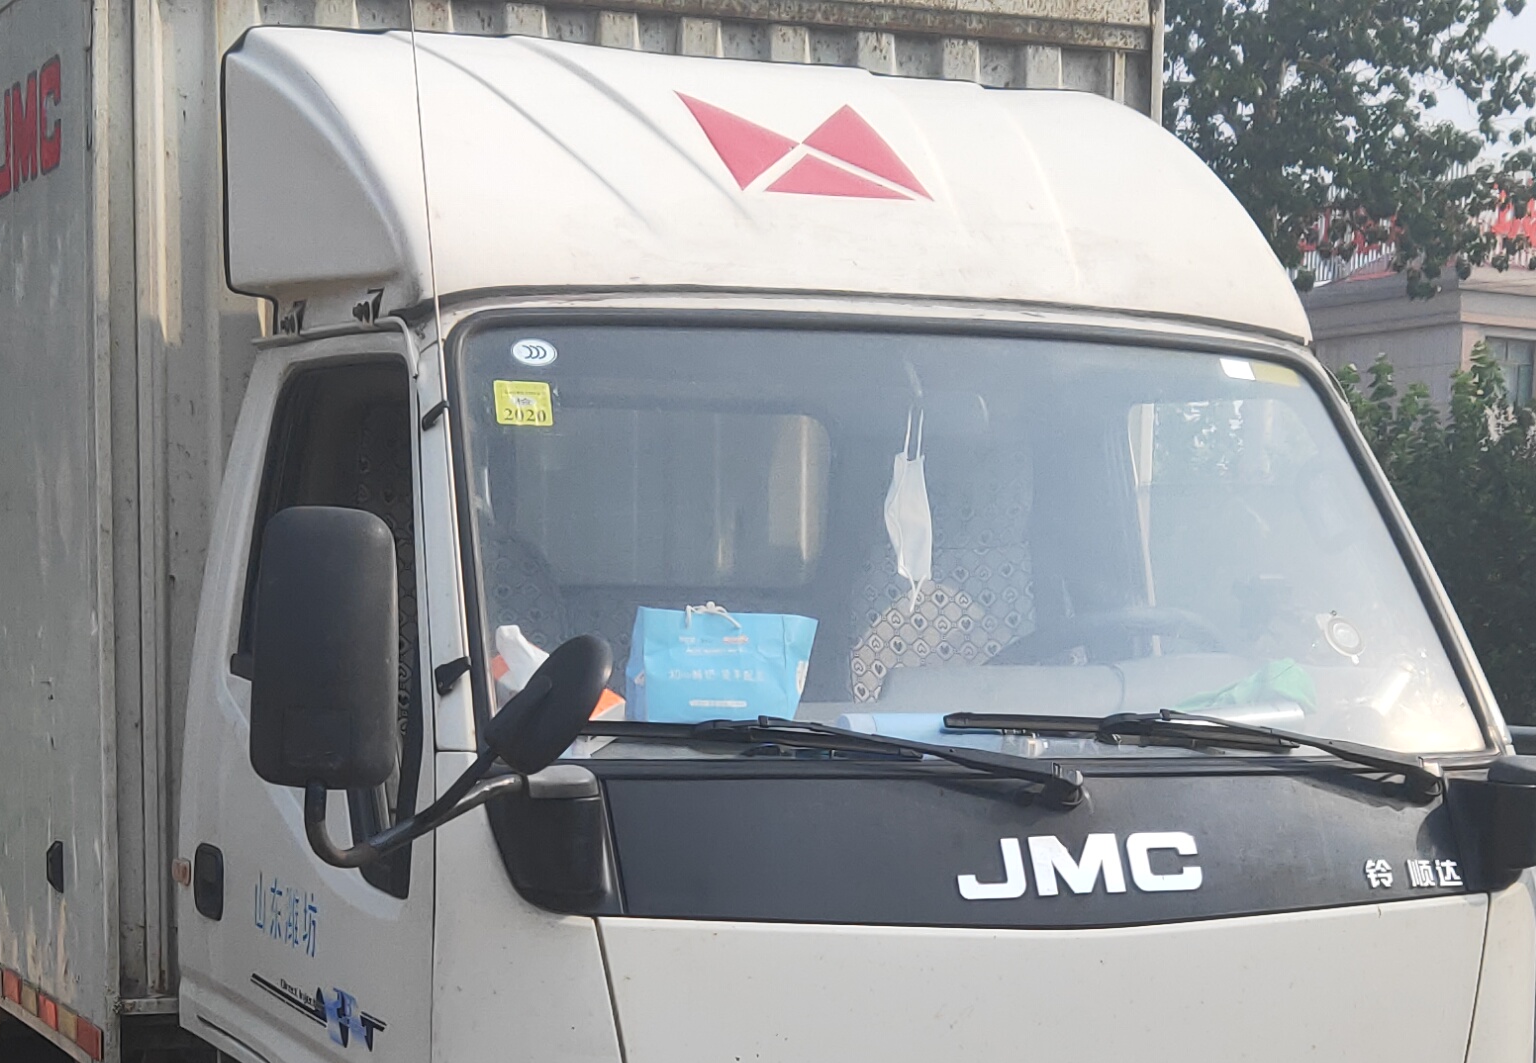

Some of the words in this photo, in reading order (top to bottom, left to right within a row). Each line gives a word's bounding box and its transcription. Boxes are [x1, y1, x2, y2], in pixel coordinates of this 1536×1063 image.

[504, 408, 547, 423] 2020
[957, 831, 1202, 901] JMC
[254, 870, 319, 958] 山东潍坊
